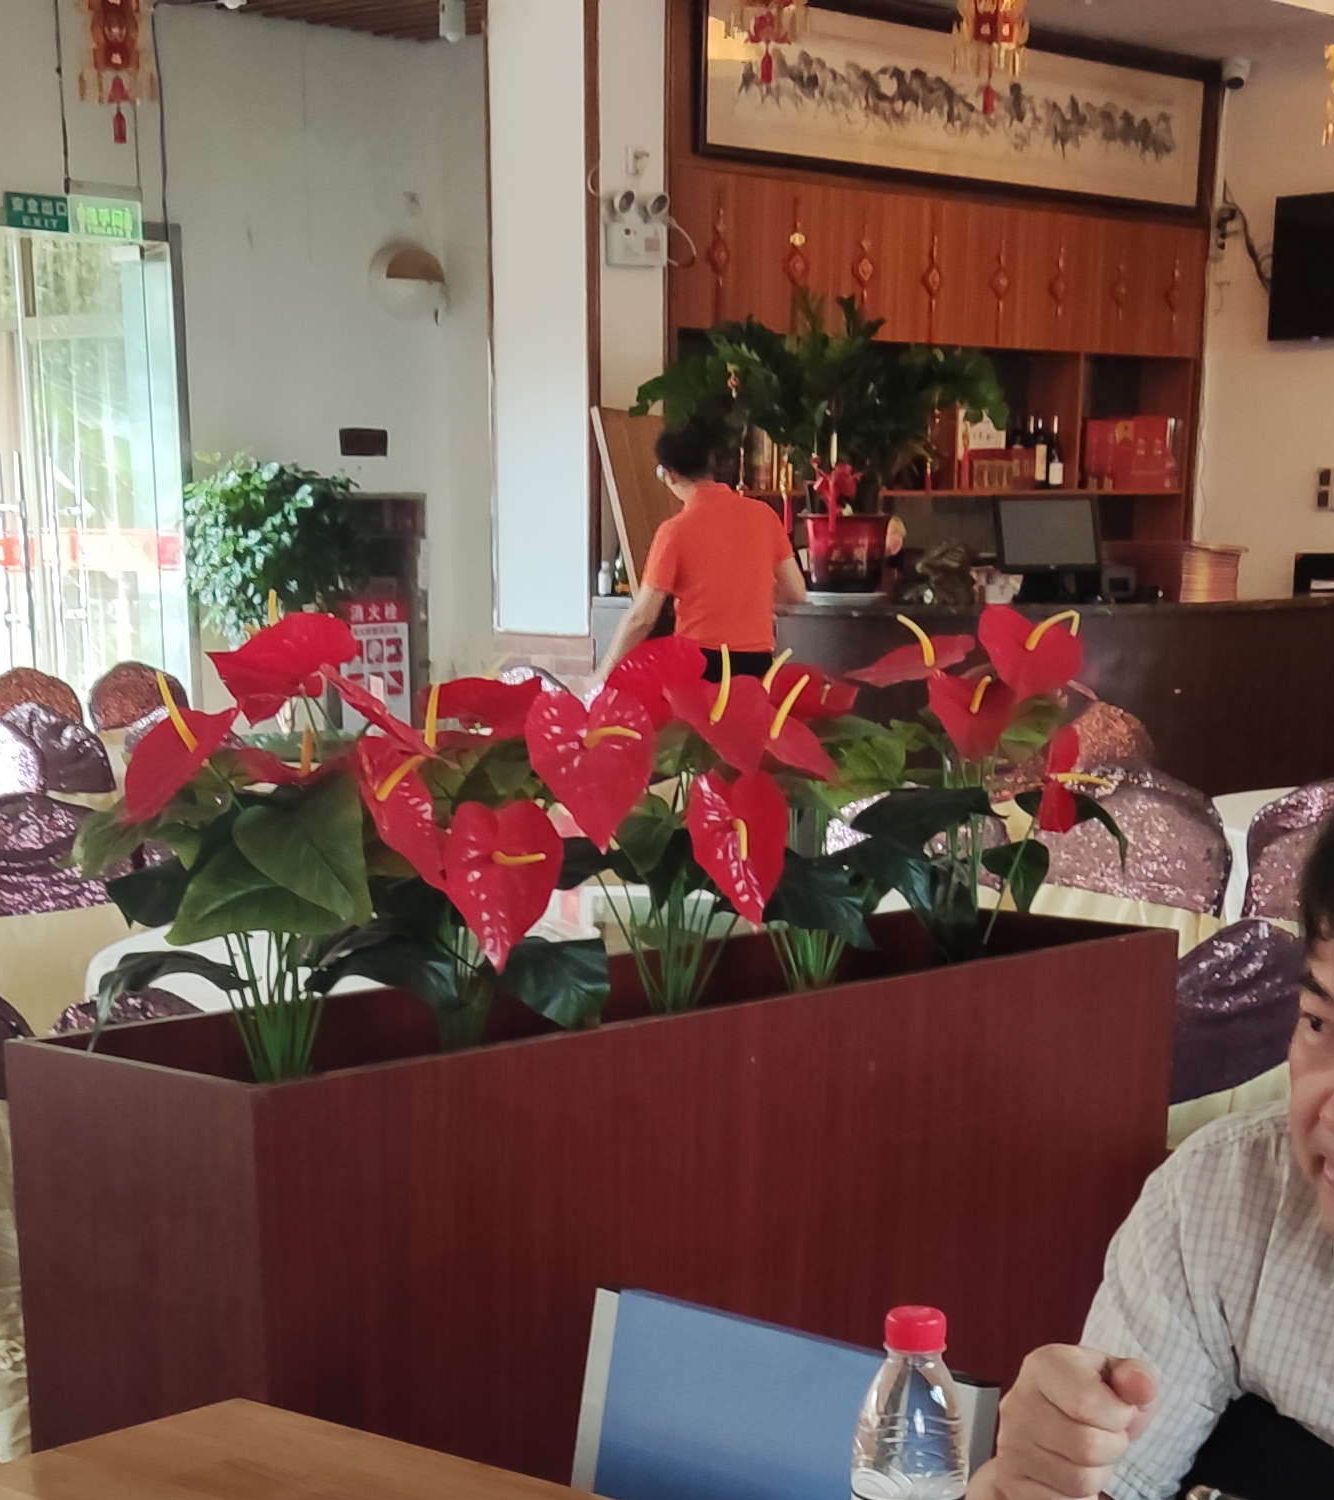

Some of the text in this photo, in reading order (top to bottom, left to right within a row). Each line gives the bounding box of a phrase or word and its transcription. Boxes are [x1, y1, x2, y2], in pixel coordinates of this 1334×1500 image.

[21, 215, 59, 230] EXIT
[349, 602, 398, 622] 消火栓
